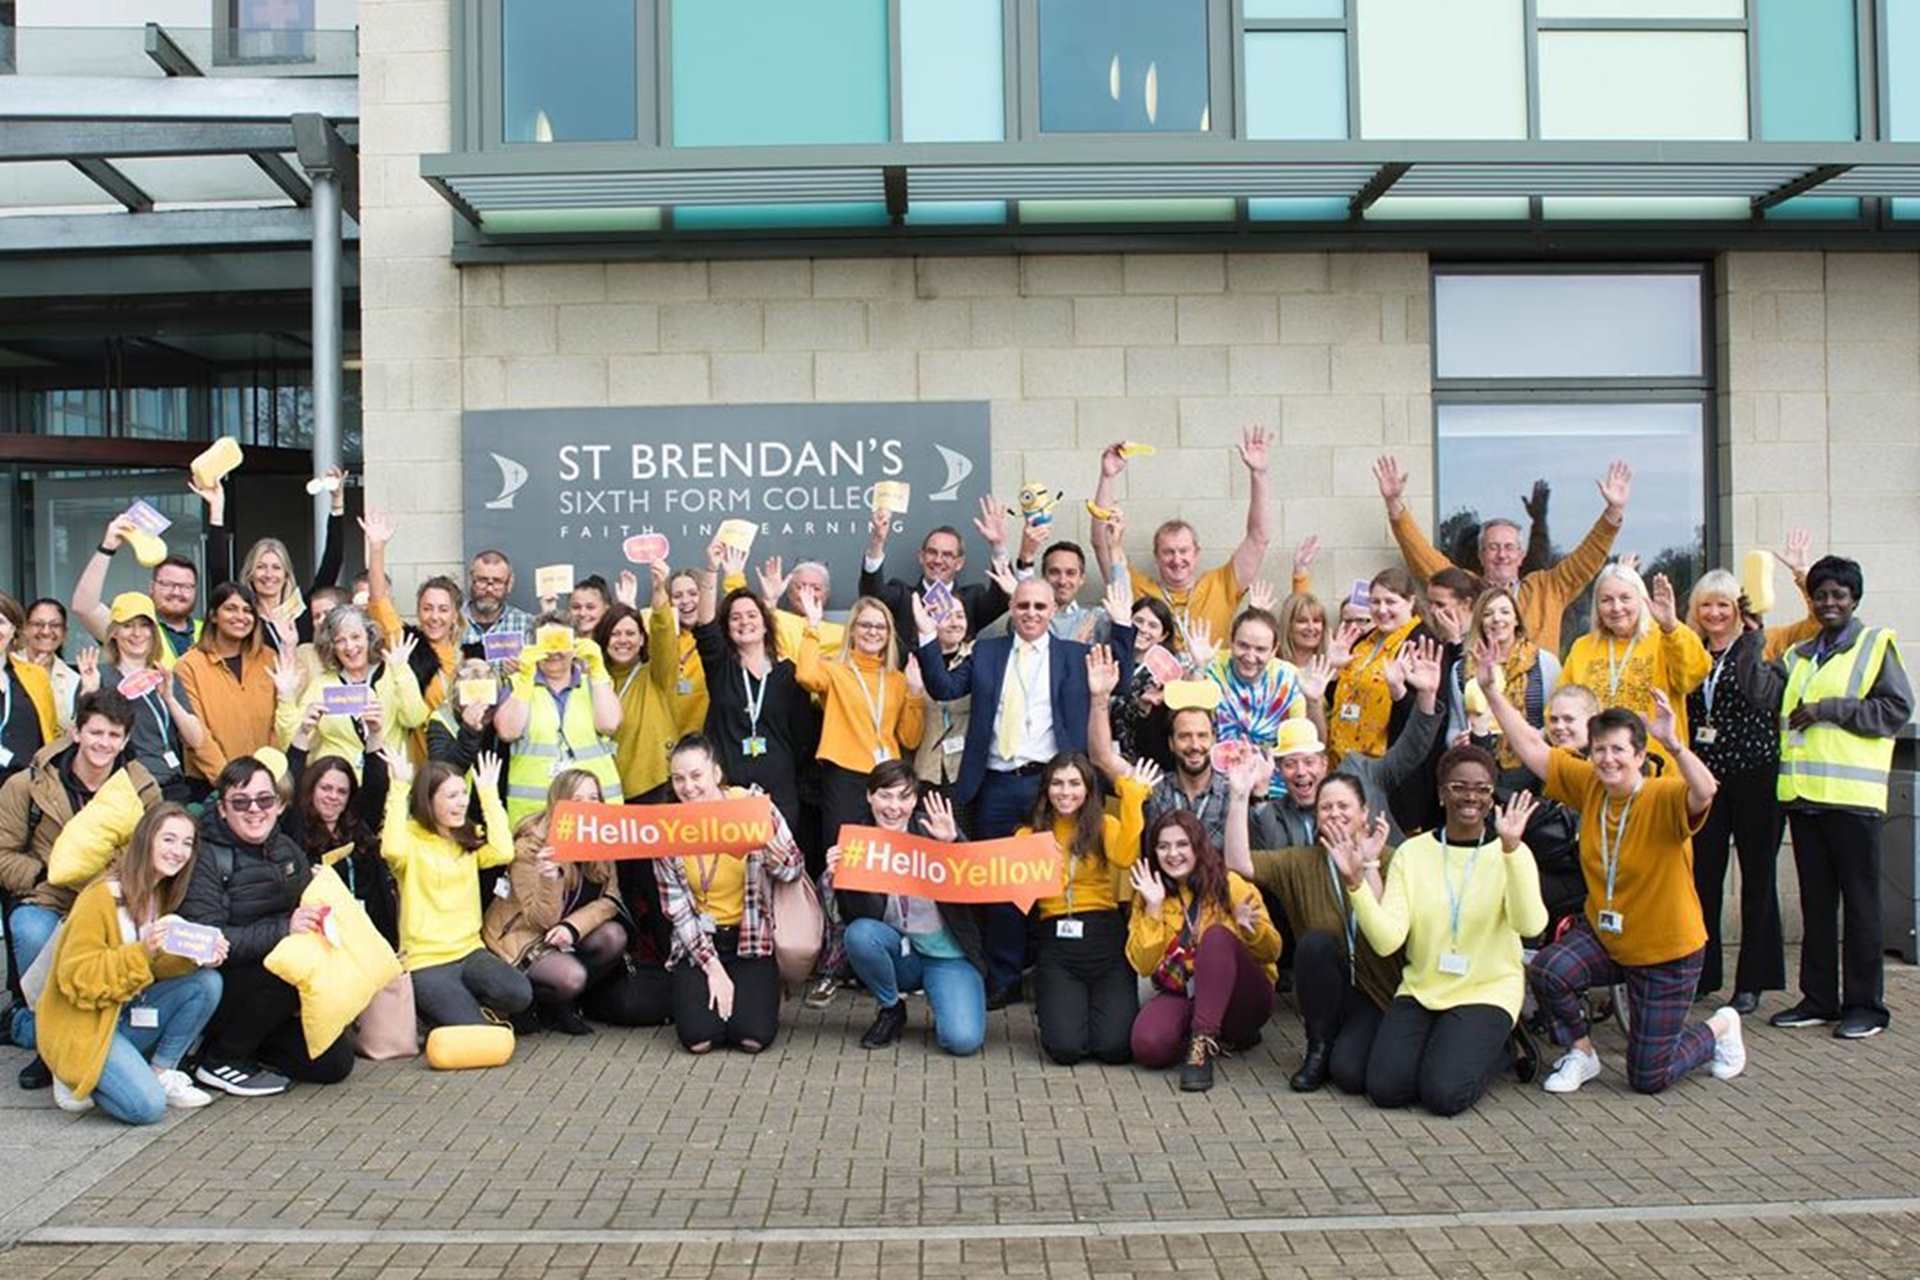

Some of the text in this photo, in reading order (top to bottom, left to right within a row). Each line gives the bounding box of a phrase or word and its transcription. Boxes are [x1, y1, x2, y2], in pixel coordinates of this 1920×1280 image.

[558, 437, 904, 481] ST BRENDAN'S
[559, 489, 650, 515] SIXTH
[665, 487, 750, 512] FORM
[560, 525, 654, 539] FAITH
[682, 523, 713, 536] IN
[556, 813, 769, 845] #HelloYellow
[843, 839, 1056, 886] #HelloYellow
